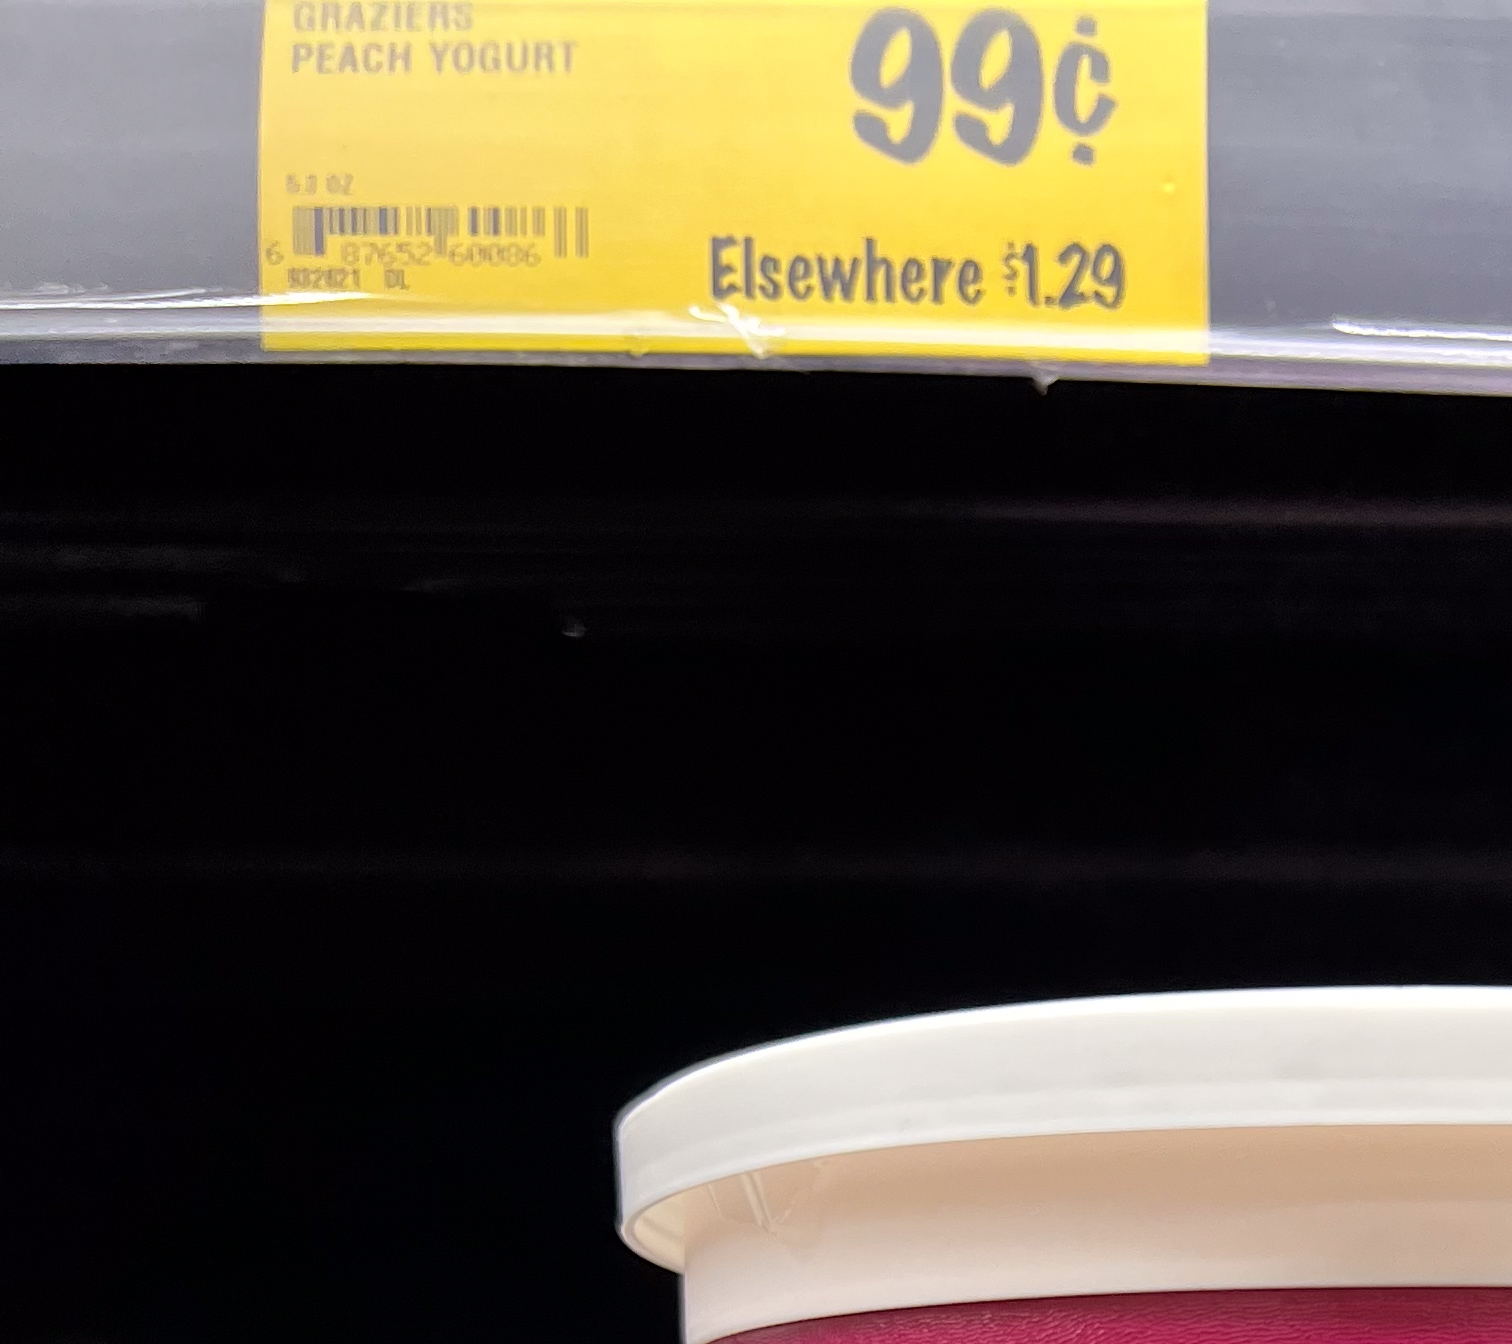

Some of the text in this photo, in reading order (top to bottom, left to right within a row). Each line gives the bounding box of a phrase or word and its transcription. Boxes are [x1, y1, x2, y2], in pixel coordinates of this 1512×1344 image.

[292, 1, 474, 32] GRAZIERS
[291, 40, 579, 75] PEACH YOGURT
[850, 7, 1118, 166] 99¢
[709, 236, 1127, 311] Elsewhere $1.29
